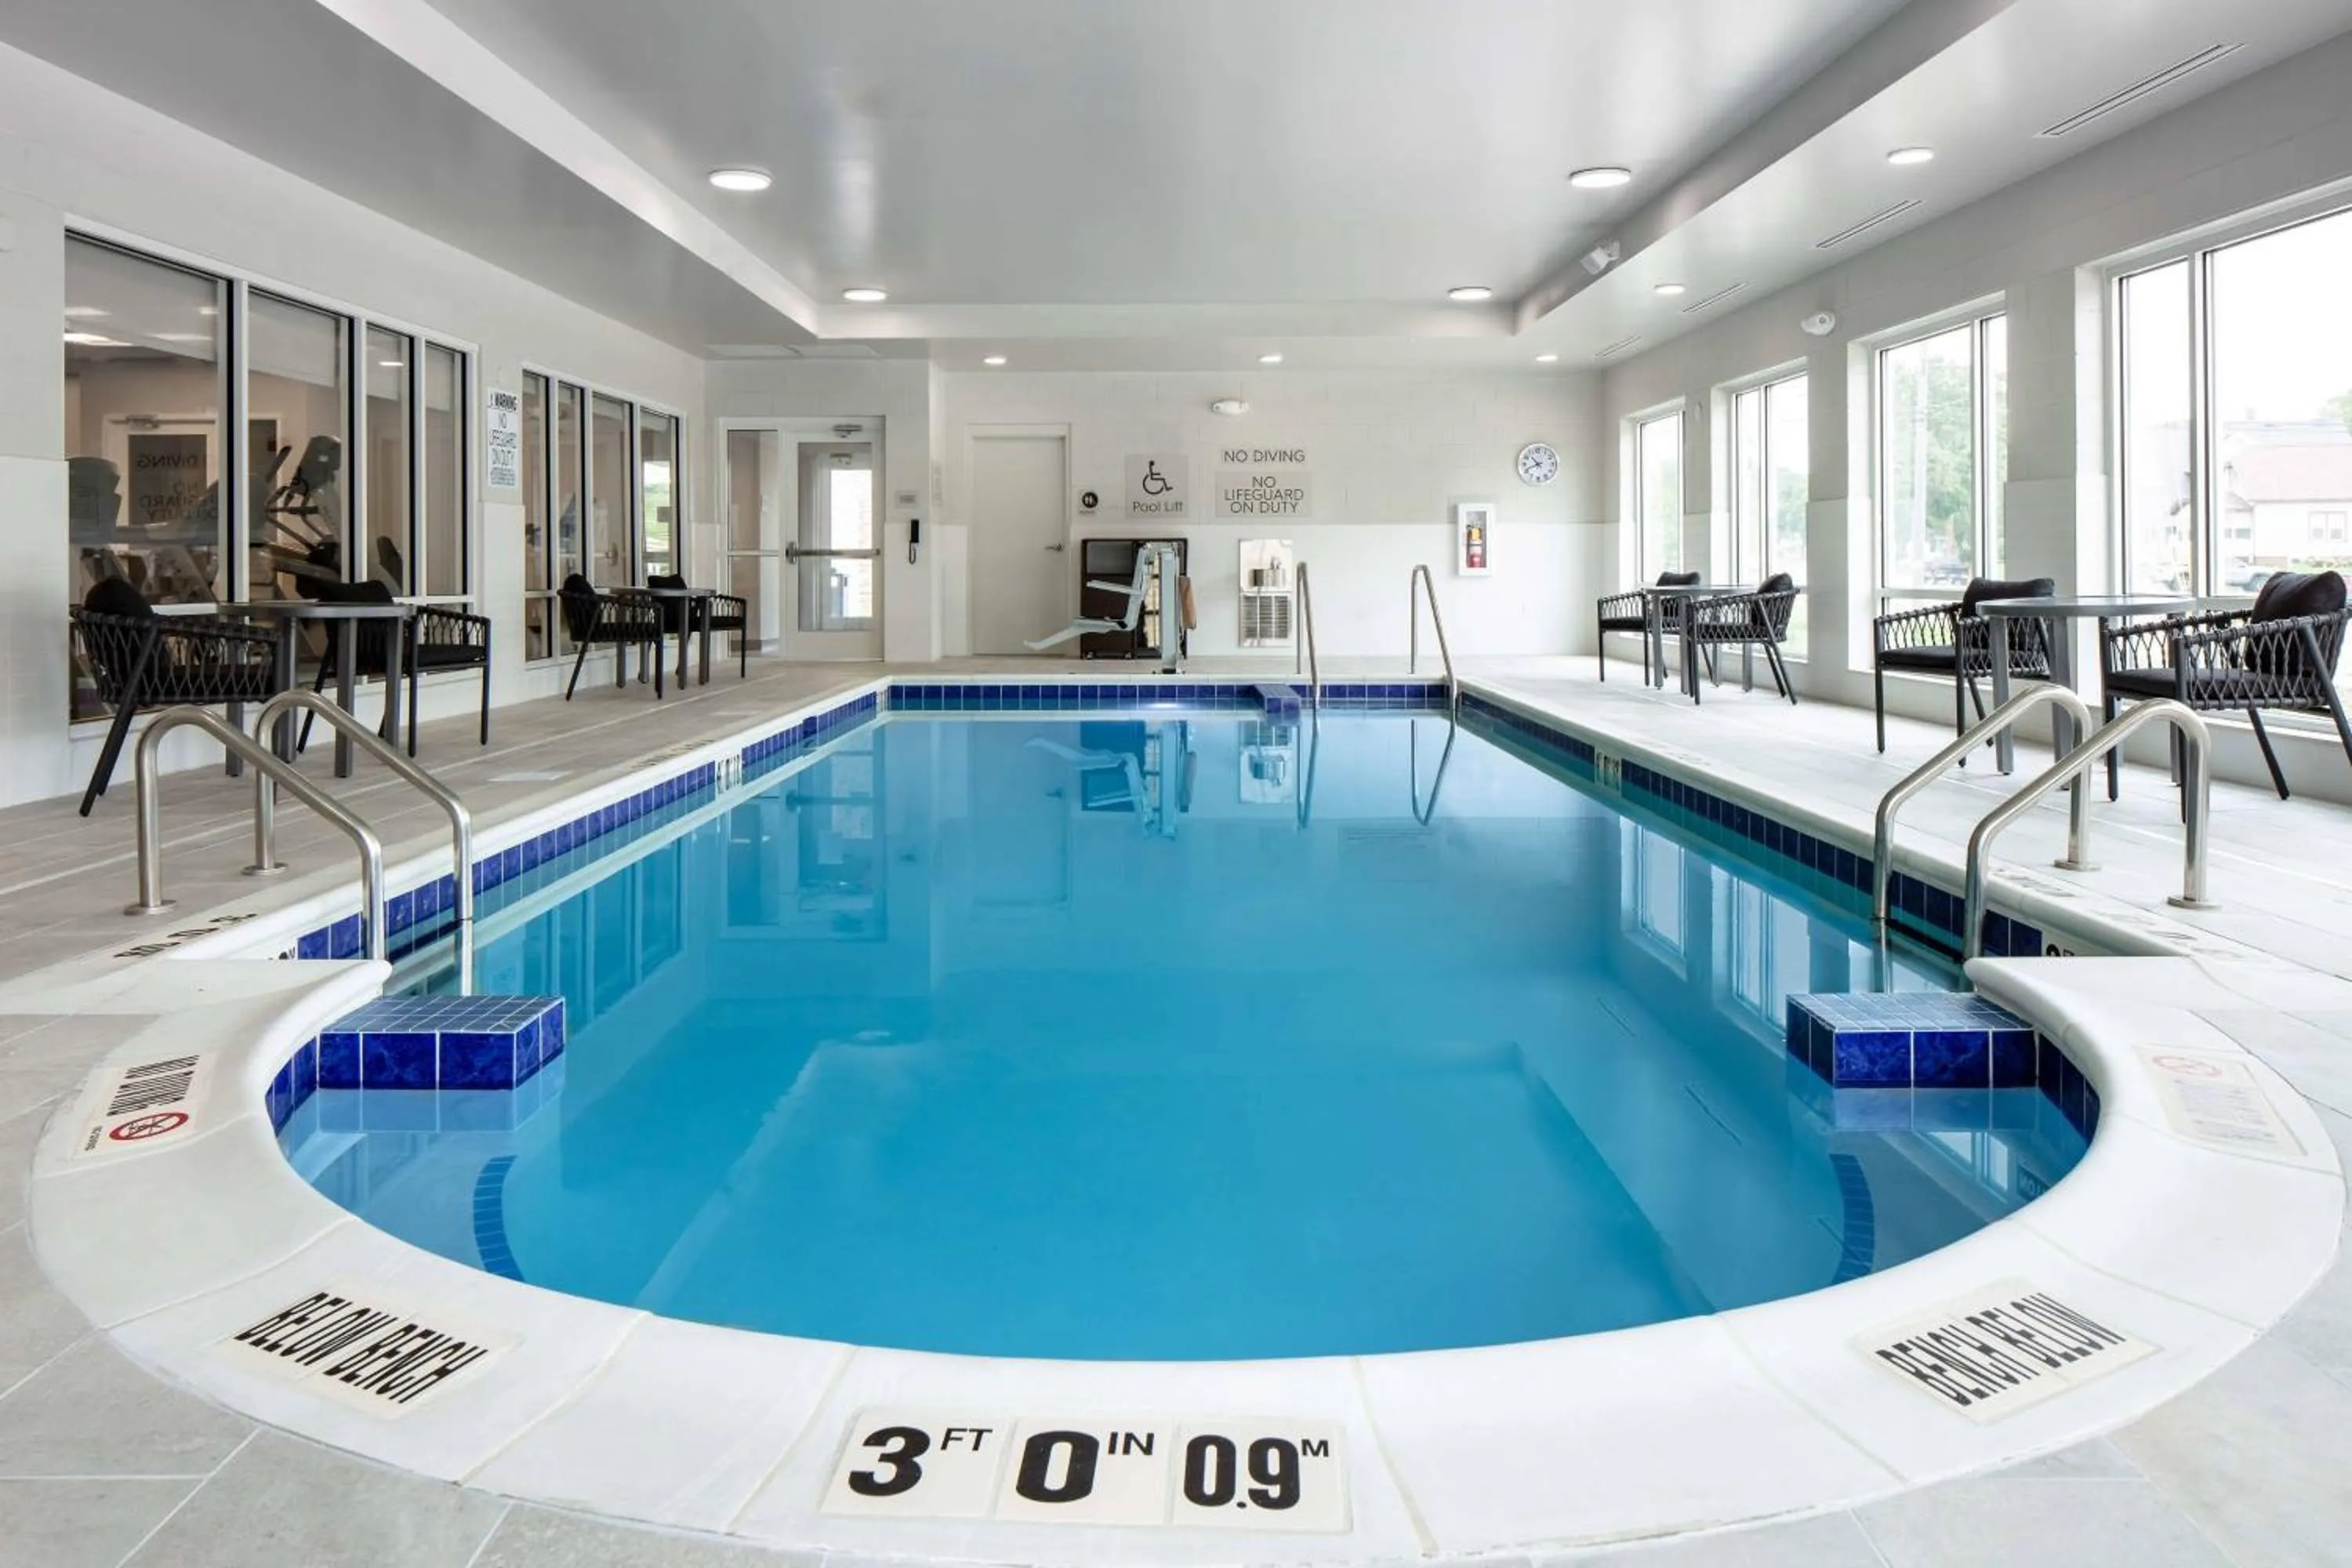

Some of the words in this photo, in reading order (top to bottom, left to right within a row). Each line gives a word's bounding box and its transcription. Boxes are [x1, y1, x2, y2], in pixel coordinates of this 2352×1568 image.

[1224, 450, 1248, 463] NO
[1253, 450, 1305, 463] DIVING
[1252, 476, 1276, 488] NO
[1225, 488, 1304, 502] LIFEGUARD
[1133, 501, 1160, 514] Pool
[1165, 501, 1183, 513] Lift
[1230, 501, 1253, 514] ON
[1258, 501, 1299, 514] DUTY
[234, 1292, 397, 1366] BELOW
[322, 1323, 488, 1403] BENCH
[1875, 1324, 2042, 1406] BENCH
[1965, 1292, 2127, 1369] BELOW
[848, 1425, 931, 1497] 3
[940, 1427, 993, 1452] FT
[1014, 1429, 1100, 1504] 0
[1107, 1432, 1155, 1456] IN
